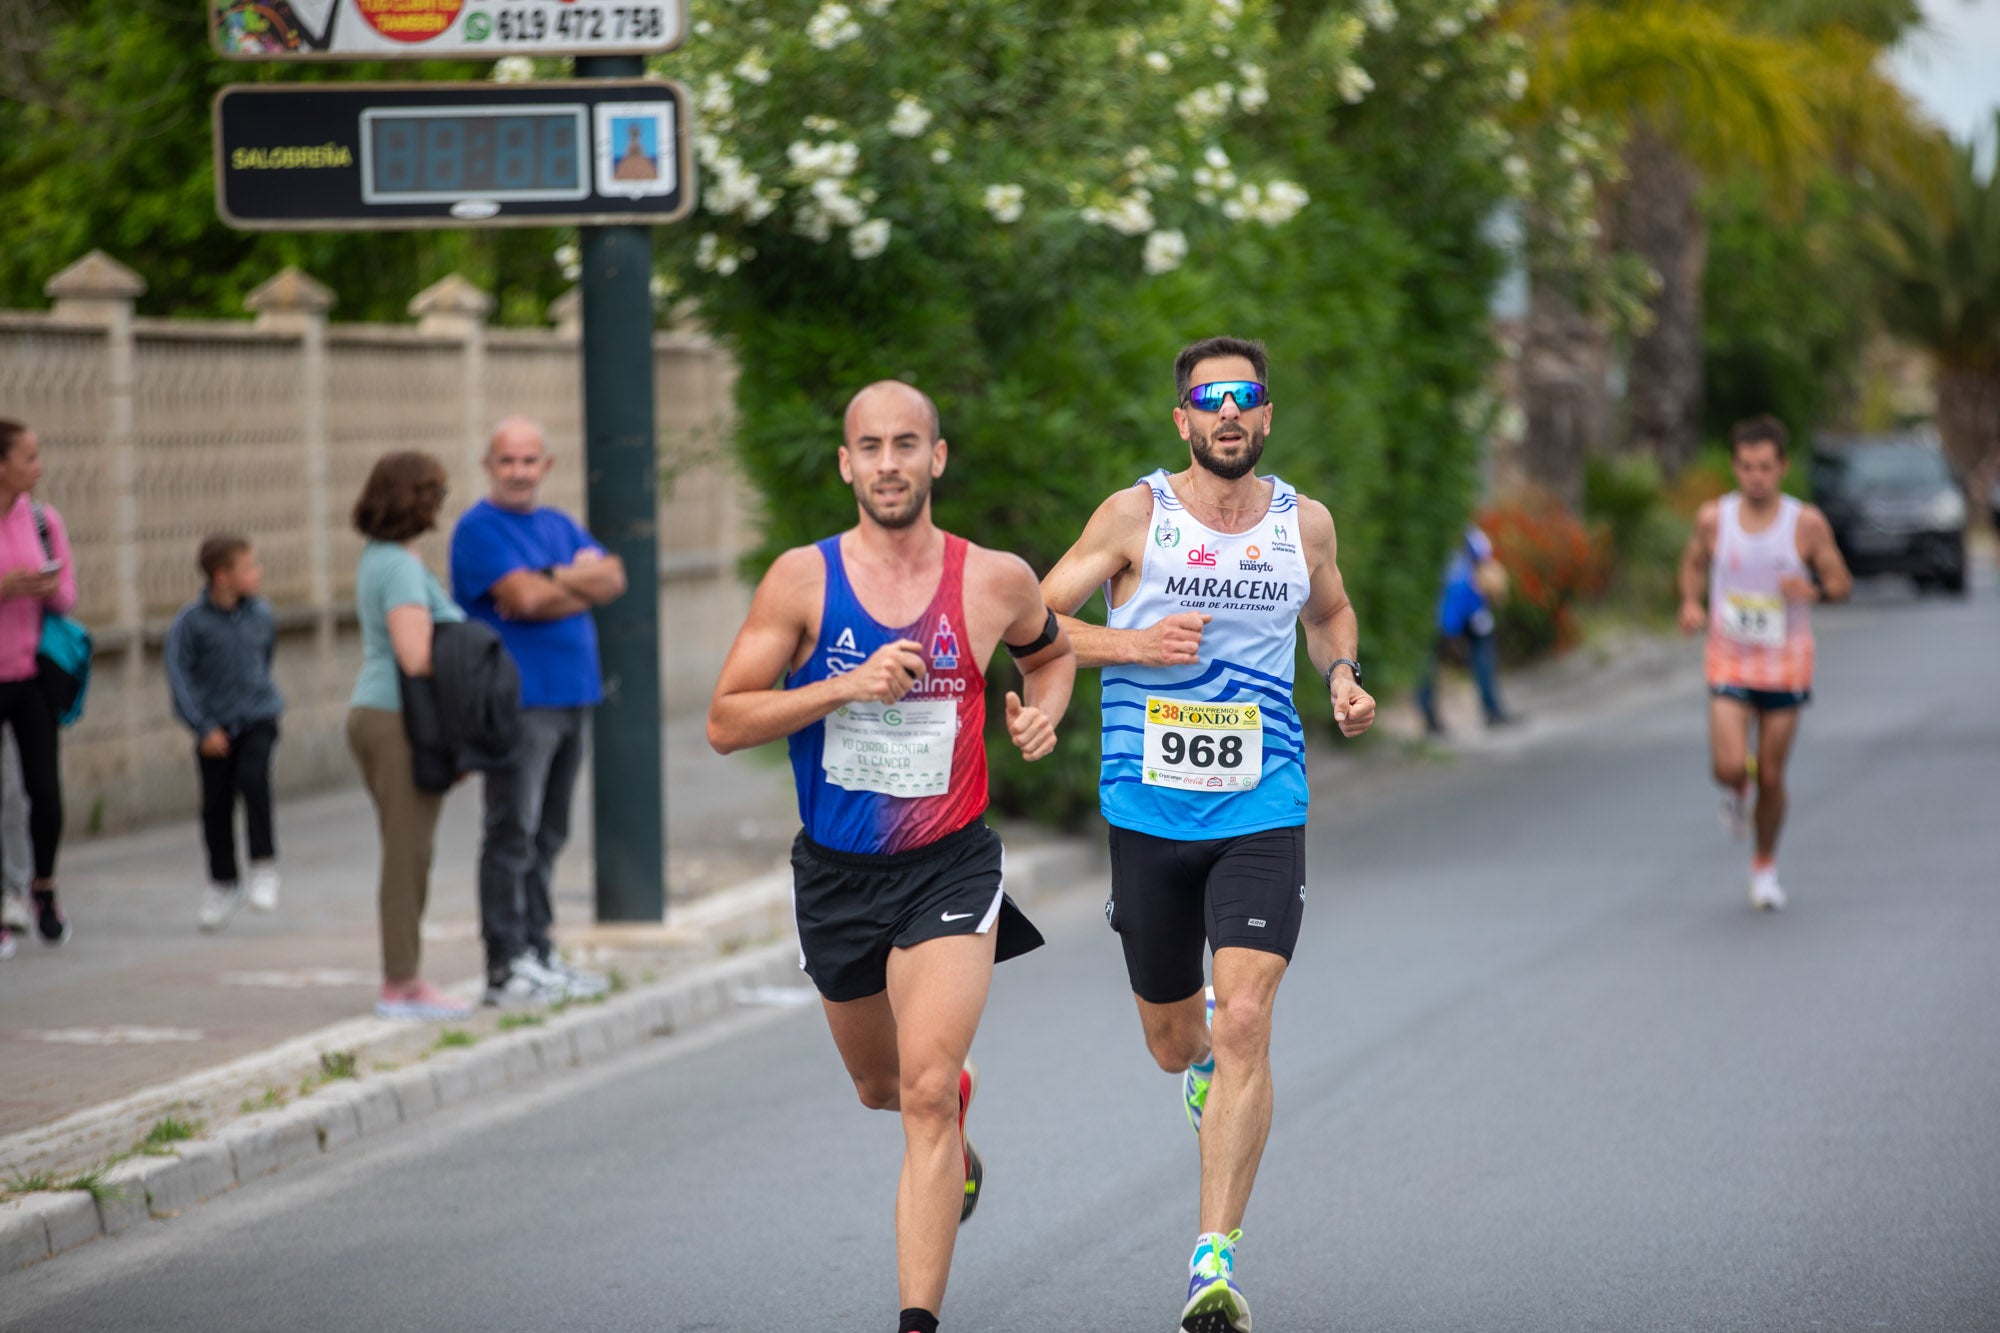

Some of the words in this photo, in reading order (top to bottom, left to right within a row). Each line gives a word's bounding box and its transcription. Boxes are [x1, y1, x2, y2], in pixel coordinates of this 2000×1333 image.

[497, 9, 546, 40] 619
[557, 8, 604, 39] 472
[613, 7, 662, 39] 758
[231, 142, 352, 170] SALOBREÑA
[1165, 576, 1288, 601] MARACENA
[1180, 600, 1205, 609] CLUB
[1208, 601, 1221, 609] DE
[1222, 602, 1275, 612] ATLETISMO
[1162, 704, 1180, 720] 38
[1183, 705, 1204, 713] GRAN
[1179, 711, 1239, 725] FONDO
[855, 740, 889, 754] CORRO
[891, 742, 929, 755] CONTRA
[1161, 732, 1243, 768] 968
[857, 754, 868, 766] EL
